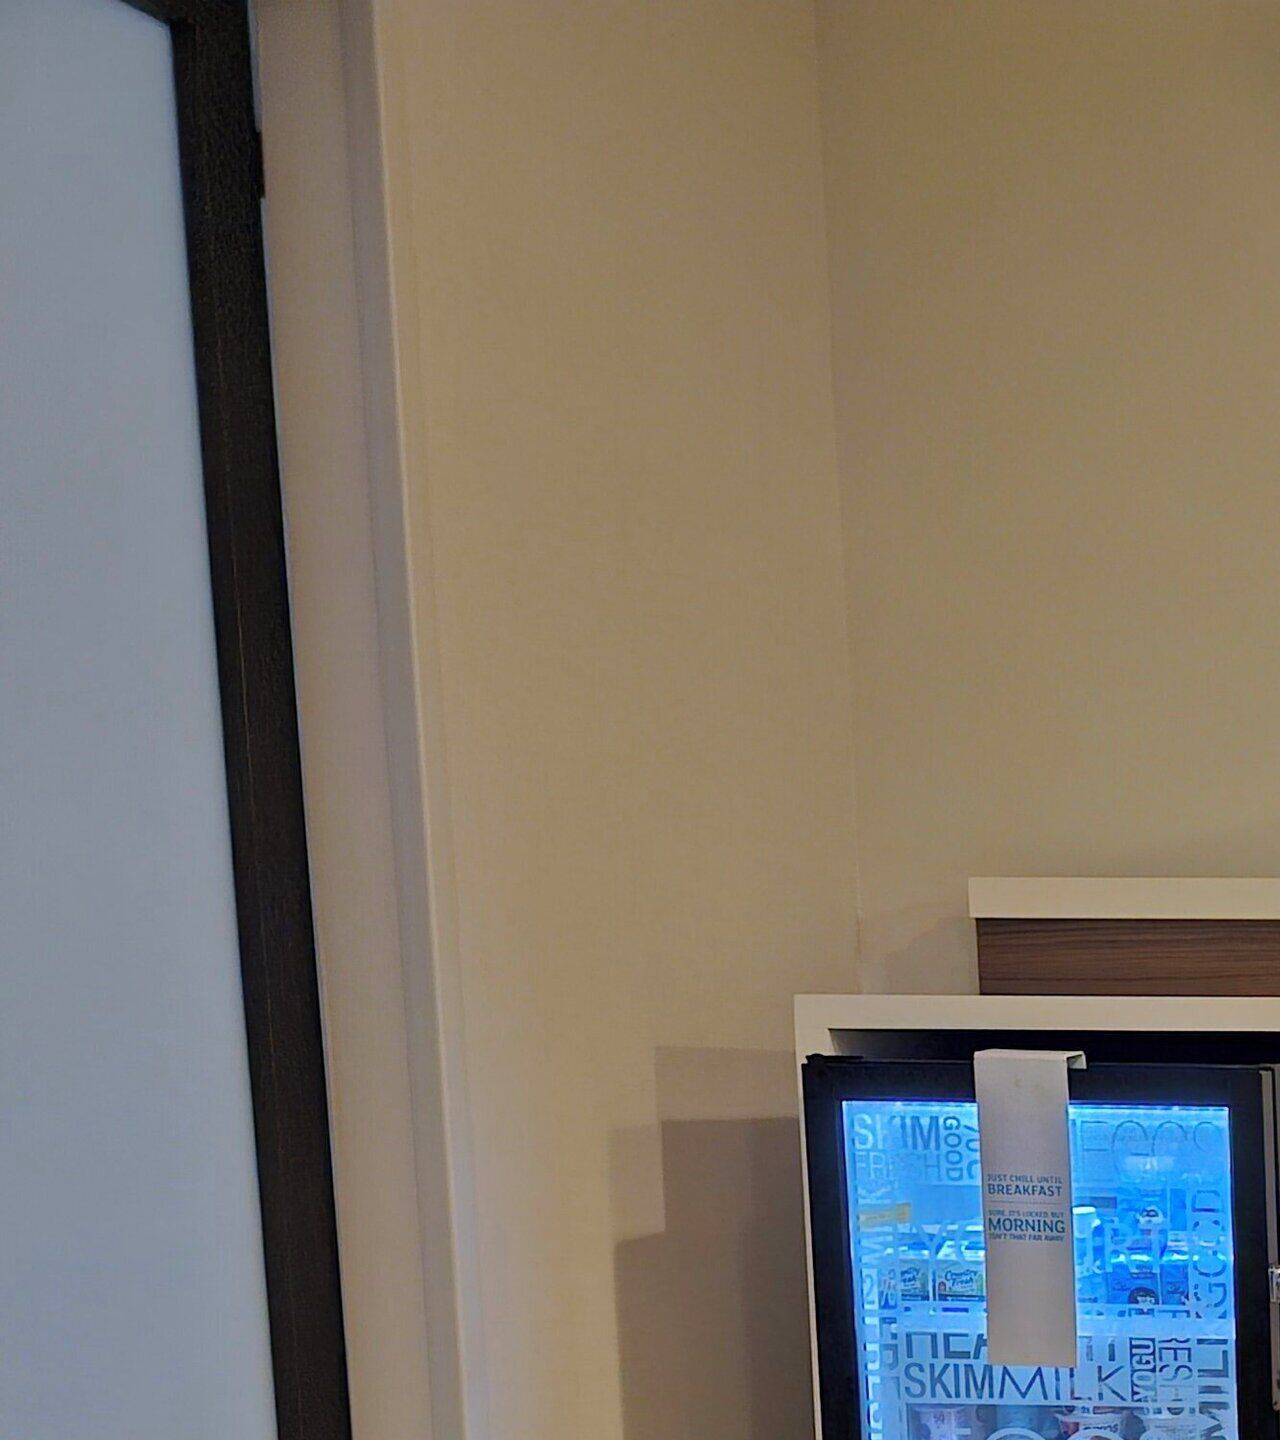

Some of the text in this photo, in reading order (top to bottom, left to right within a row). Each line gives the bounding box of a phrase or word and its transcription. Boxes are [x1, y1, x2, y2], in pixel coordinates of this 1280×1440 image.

[987, 1183, 1063, 1197] BREAKFAST
[988, 1217, 1066, 1233] MORNING
[1129, 1318, 1158, 1403] YOGU
